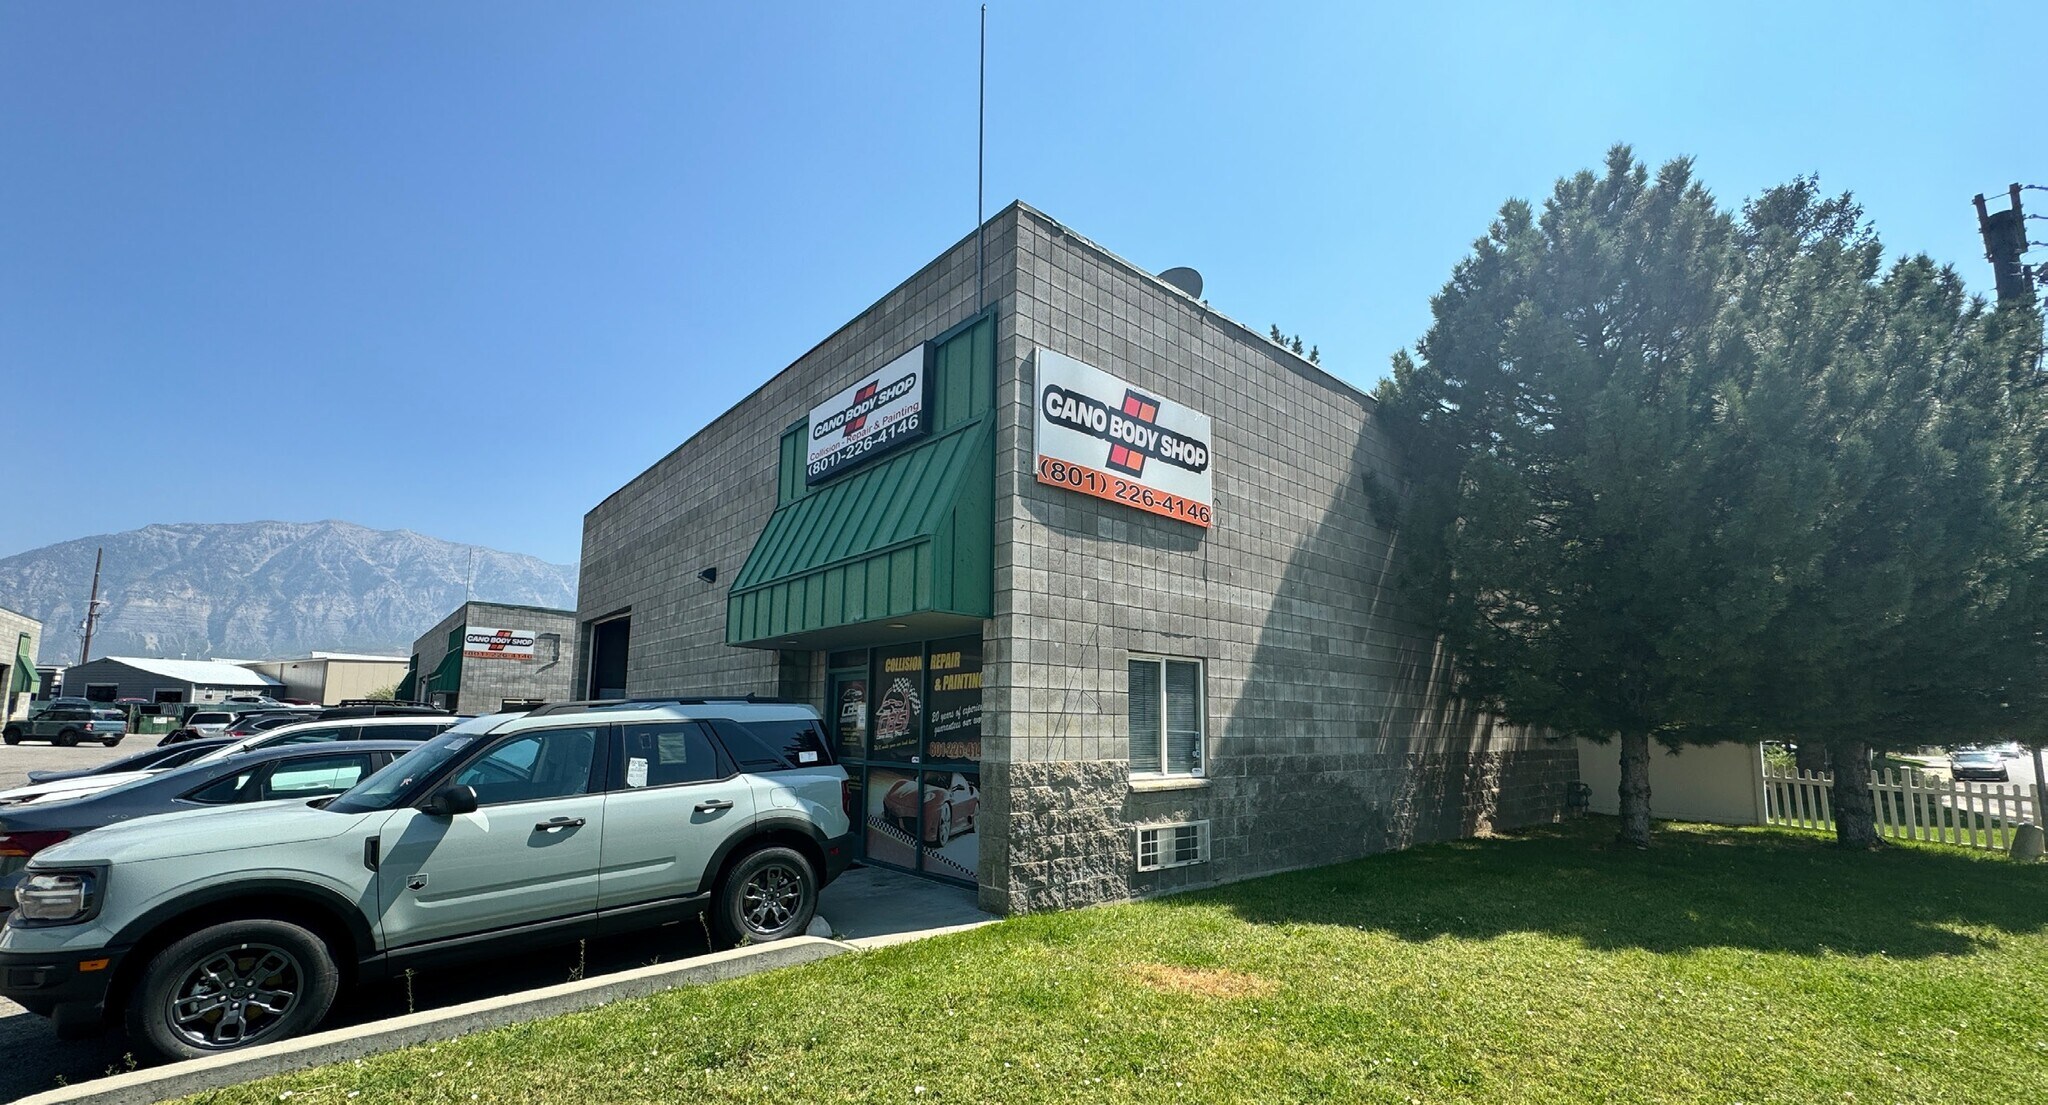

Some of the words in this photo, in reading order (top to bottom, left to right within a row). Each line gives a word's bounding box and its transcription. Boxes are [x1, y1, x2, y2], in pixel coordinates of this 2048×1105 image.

[809, 442, 840, 461] Collision
[846, 425, 873, 443] Repair
[873, 420, 880, 431] &
[882, 401, 920, 425] Painting
[814, 415, 845, 438] CANO
[845, 395, 878, 421] BODY
[877, 375, 916, 405] SHOP
[1045, 392, 1107, 433] CANO
[1109, 414, 1159, 452] BODY
[1160, 434, 1206, 468] SHOP
[808, 414, 919, 476] (801)-226-4146
[1040, 459, 1107, 493] (801)
[1114, 480, 1210, 523] 226-4146
[467, 635, 490, 643] CANO
[511, 638, 533, 646] SHOP
[885, 656, 922, 673] COLLISION
[930, 652, 961, 670] REPAIR
[934, 678, 942, 691] &
